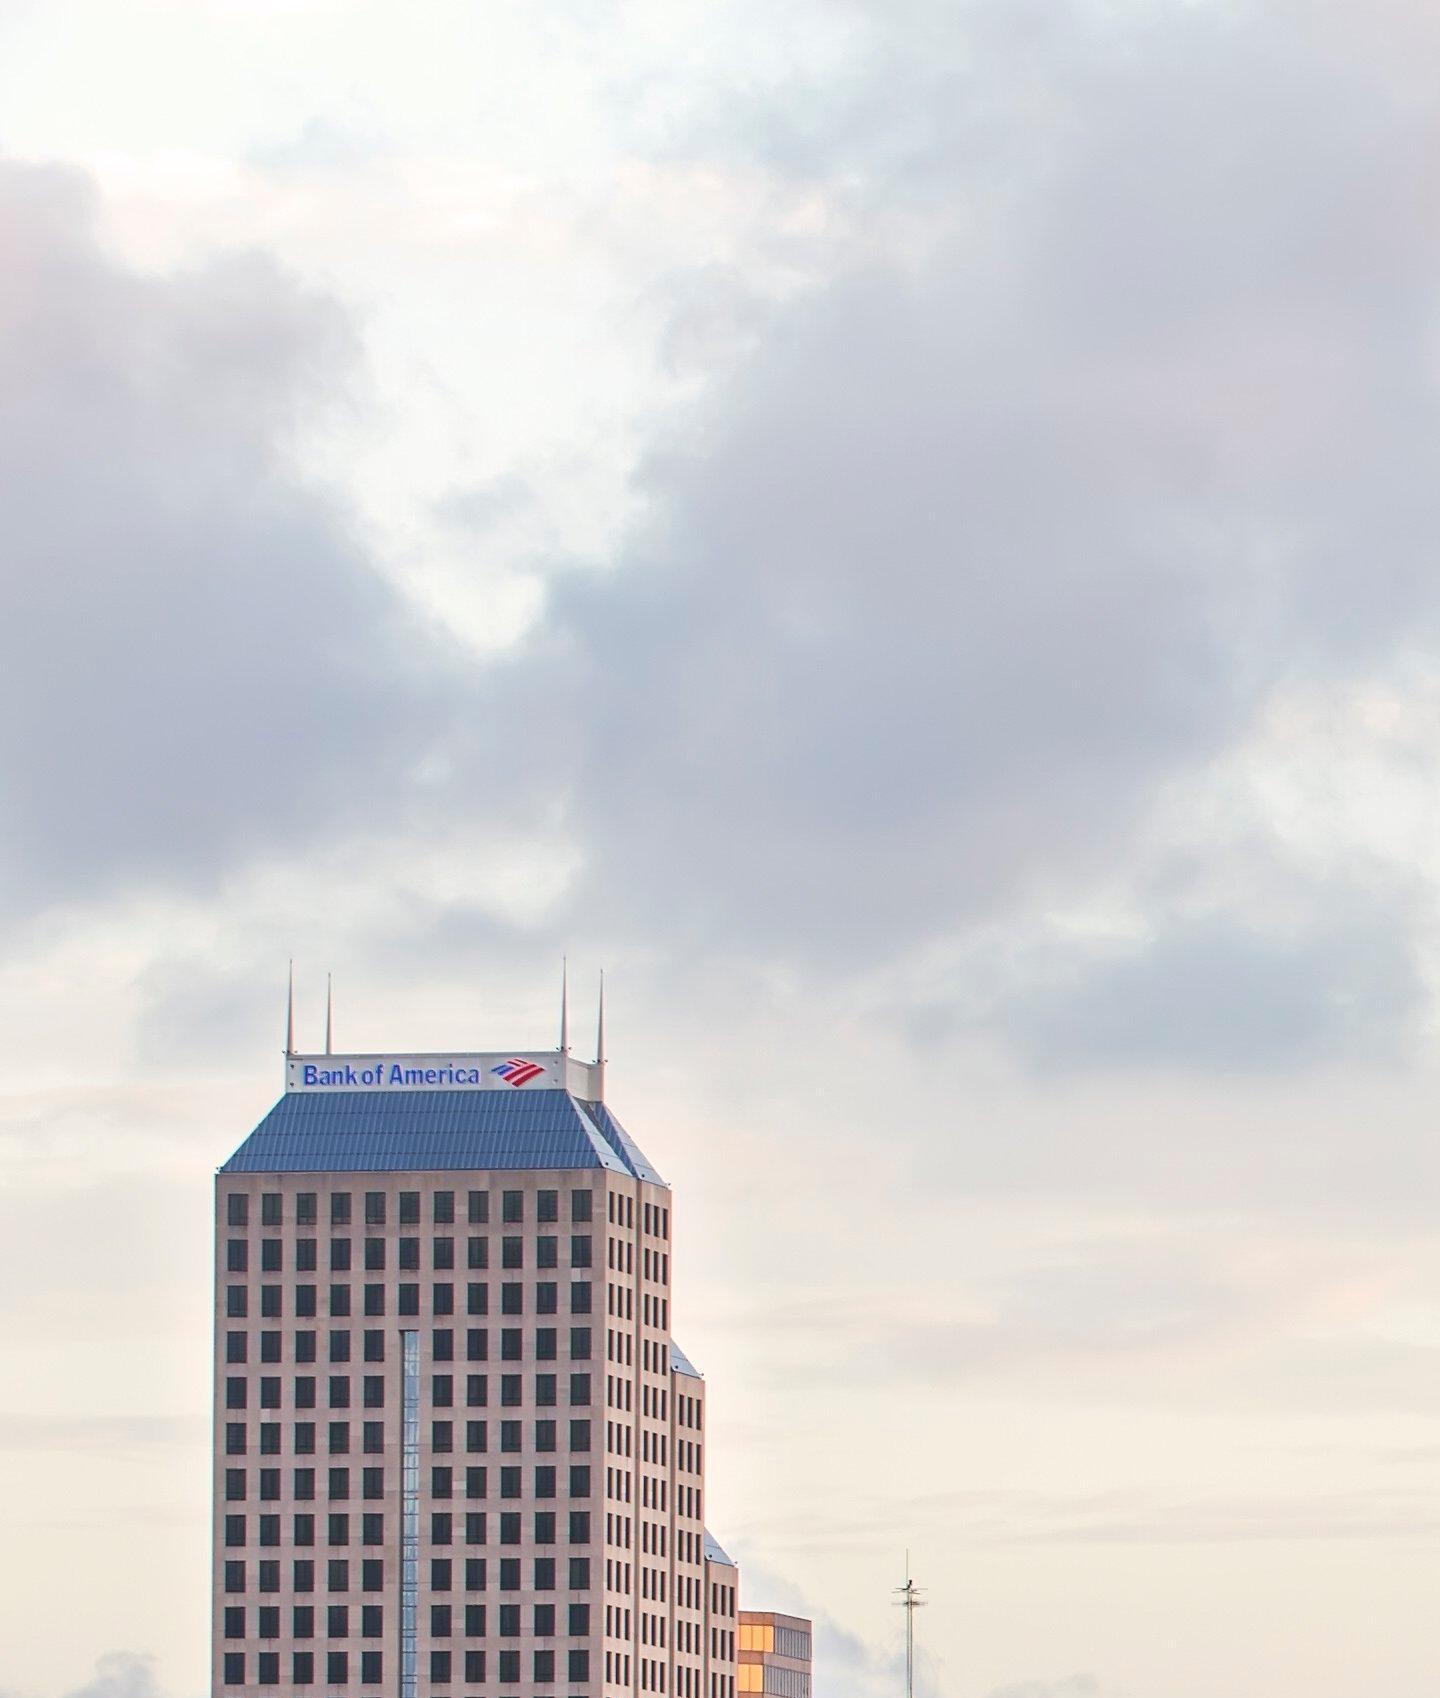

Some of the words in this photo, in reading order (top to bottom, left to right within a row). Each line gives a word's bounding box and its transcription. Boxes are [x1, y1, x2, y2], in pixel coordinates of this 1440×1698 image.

[303, 1065, 357, 1085] Bank
[362, 1064, 384, 1085] of
[389, 1064, 480, 1085] America
